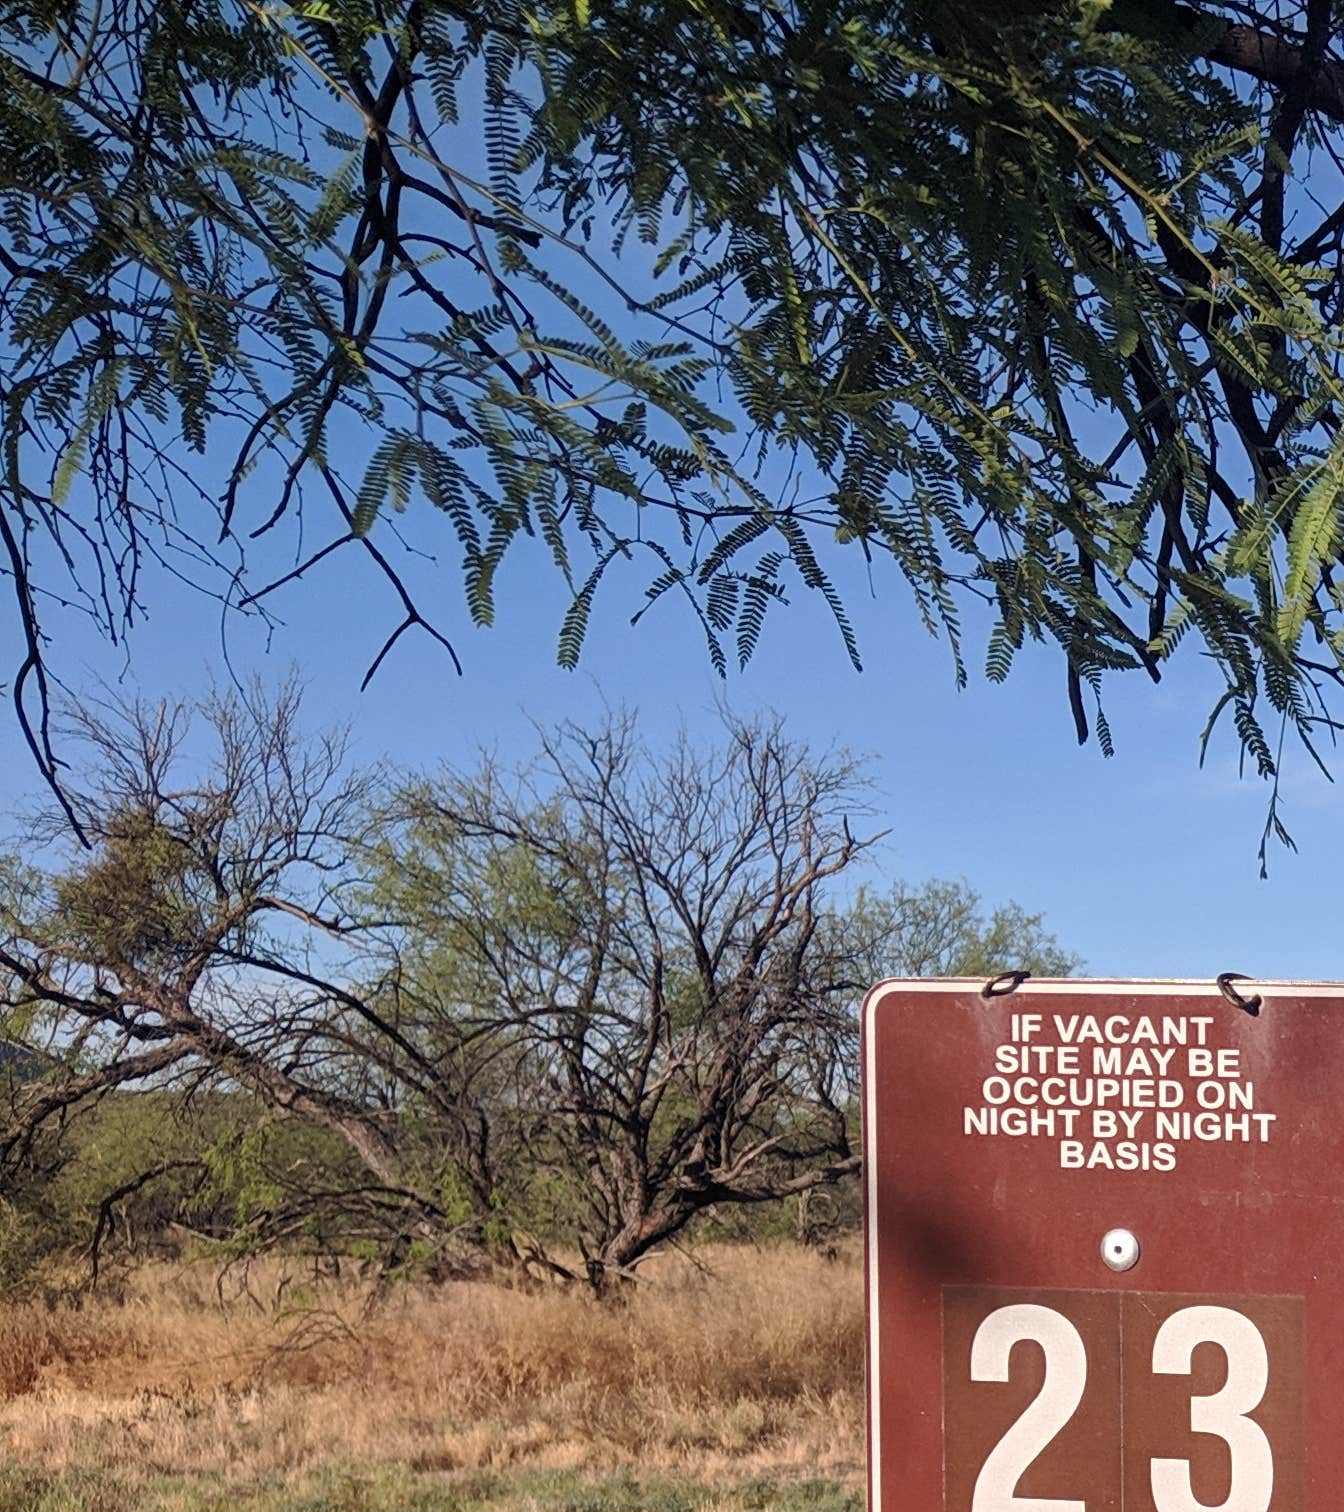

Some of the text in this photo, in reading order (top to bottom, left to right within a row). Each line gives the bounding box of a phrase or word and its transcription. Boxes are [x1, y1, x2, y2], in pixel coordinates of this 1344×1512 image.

[1011, 1013, 1214, 1046] IF VACANT
[994, 1044, 1241, 1078] SITE MAY BE
[982, 1075, 1254, 1110] OCCUPIED ON
[964, 1107, 1277, 1142] NIGHT BY NIGHT
[1060, 1140, 1177, 1172] BASIS
